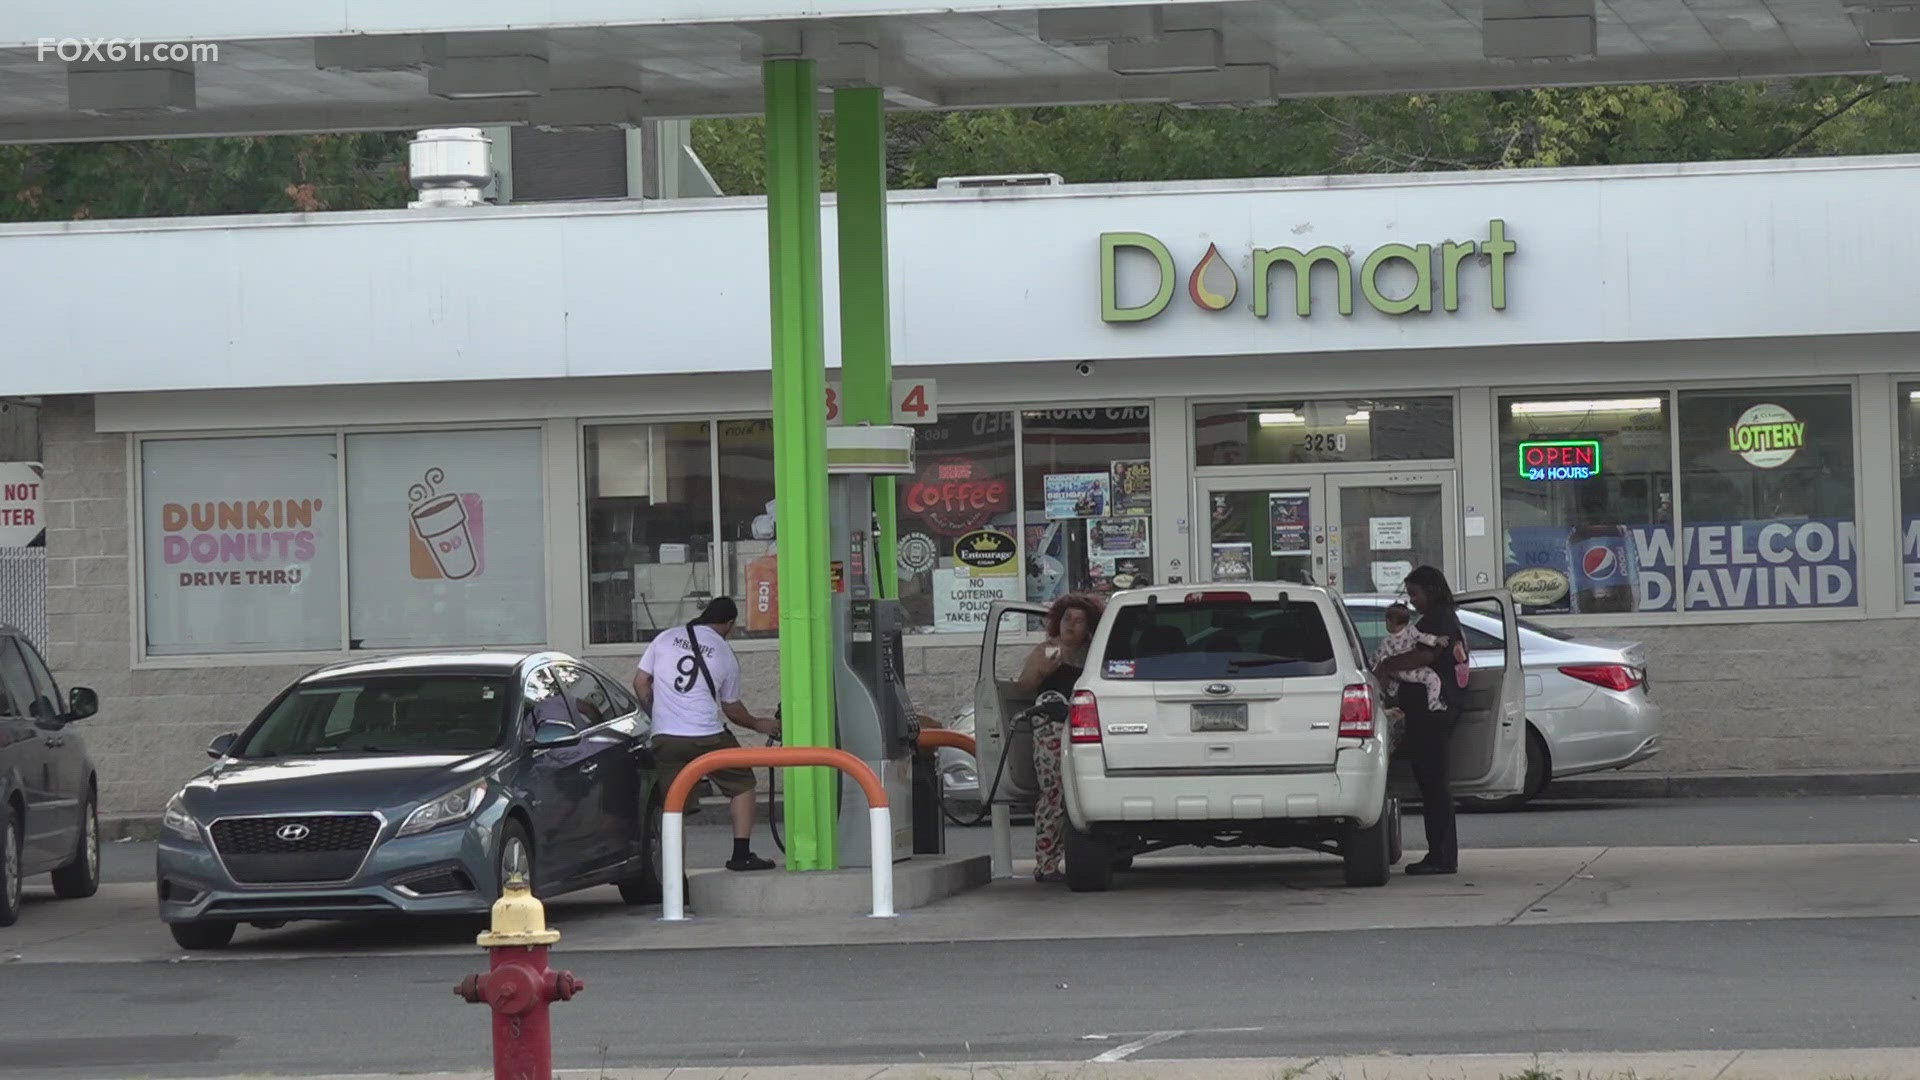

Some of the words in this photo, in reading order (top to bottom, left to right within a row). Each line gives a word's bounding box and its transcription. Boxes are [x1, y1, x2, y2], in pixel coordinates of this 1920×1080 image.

[901, 384, 929, 417] 4
[1729, 421, 1805, 451] LOTTERY
[1526, 447, 1593, 465] OPEN
[1529, 468, 1545, 480] 24
[1547, 467, 1590, 480] HOURS
[4, 483, 39, 501] NOT
[0, 508, 35, 526] TER
[163, 498, 323, 532] DUNKIN'
[163, 530, 316, 564] DONUTS
[960, 549, 1014, 561] Entourage
[180, 571, 241, 587] DRIVE
[245, 569, 302, 585] THRU
[969, 578, 985, 588] NO
[758, 581, 770, 613] ICED
[951, 589, 1004, 600] LOITERING
[959, 601, 990, 611] POLIC
[945, 612, 971, 622] TAKE
[673, 637, 715, 658] MBPE
[674, 655, 699, 694] 9
